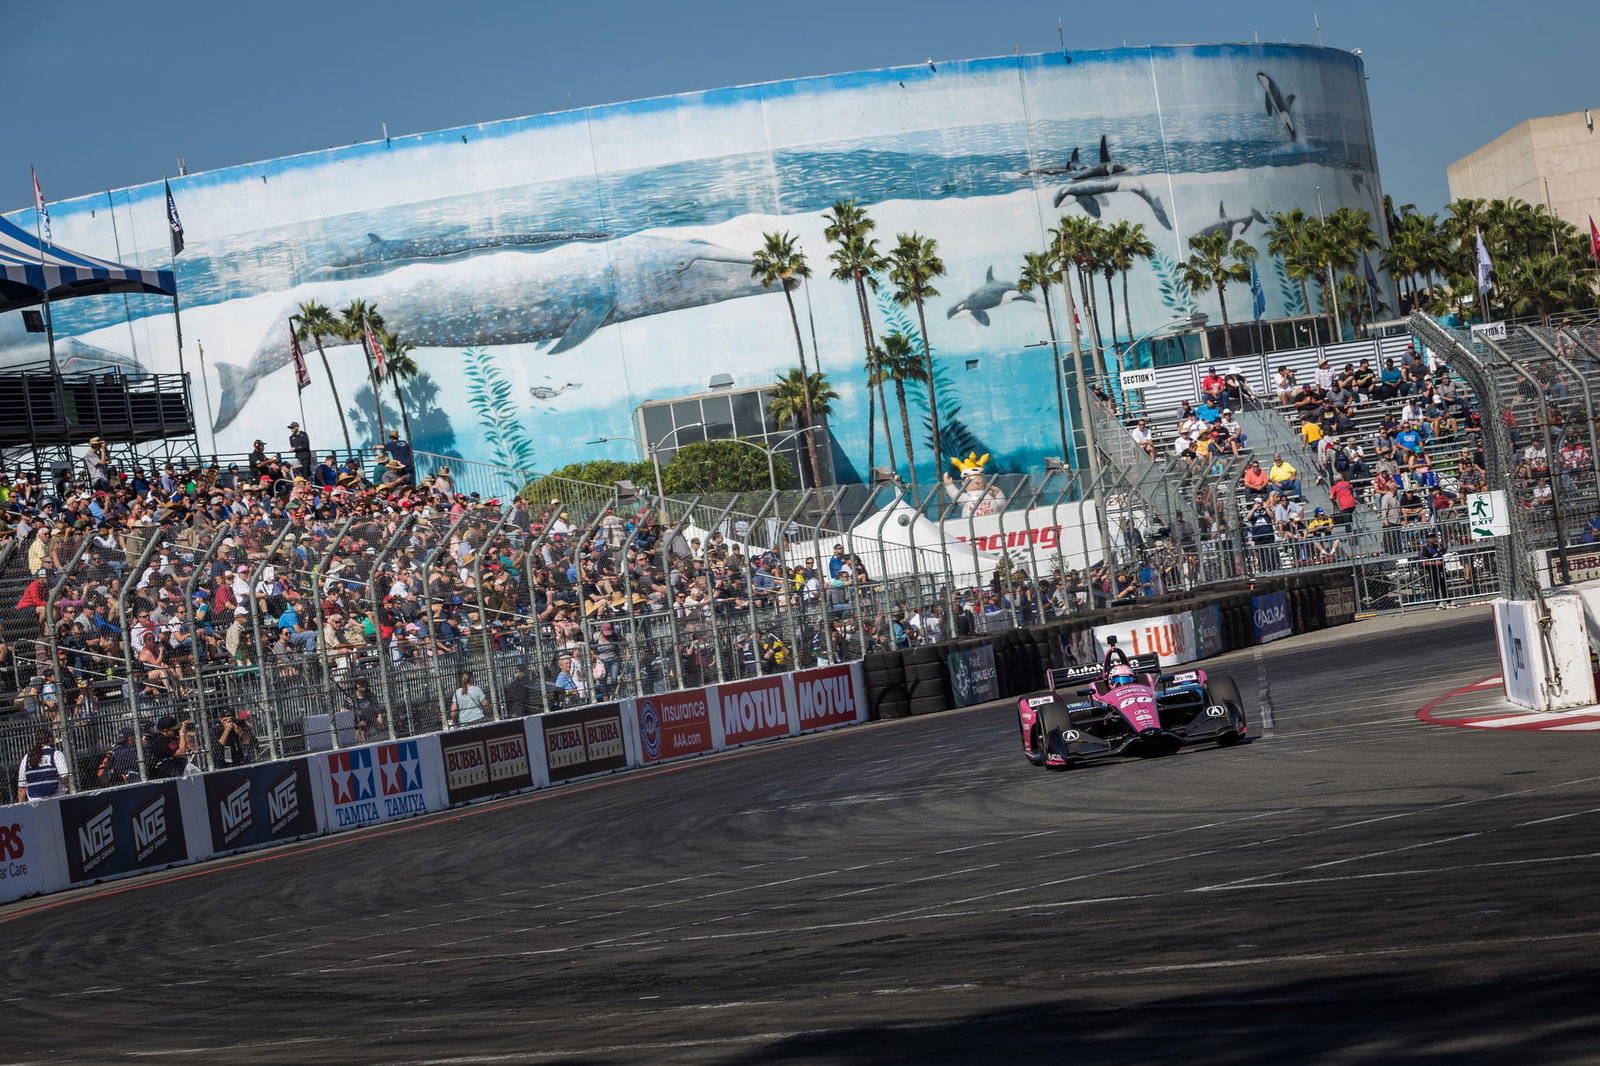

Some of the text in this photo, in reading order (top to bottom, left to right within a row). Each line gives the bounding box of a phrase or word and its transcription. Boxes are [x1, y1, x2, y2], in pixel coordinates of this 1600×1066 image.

[1473, 326, 1505, 338] STION 2
[1123, 373, 1154, 385] SECTION 1
[1555, 556, 1600, 573] BUBB
[1260, 605, 1285, 626] ACURA
[799, 675, 854, 721] MOTUL
[660, 701, 705, 722] Insurance
[724, 687, 786, 735] MOTUL
[547, 729, 582, 751] BUBBA
[587, 722, 619, 744] BUBBA
[673, 733, 702, 748] AAA.com
[447, 748, 483, 772] BUBBA
[489, 740, 523, 763] BUBBA
[220, 778, 252, 834] NOS
[267, 770, 298, 824] NOS
[384, 793, 427, 817] TAMIYA
[132, 794, 167, 851] NOS
[335, 802, 380, 827] TAMIYA
[79, 803, 114, 862] NOS
[10, 863, 28, 877] Care
